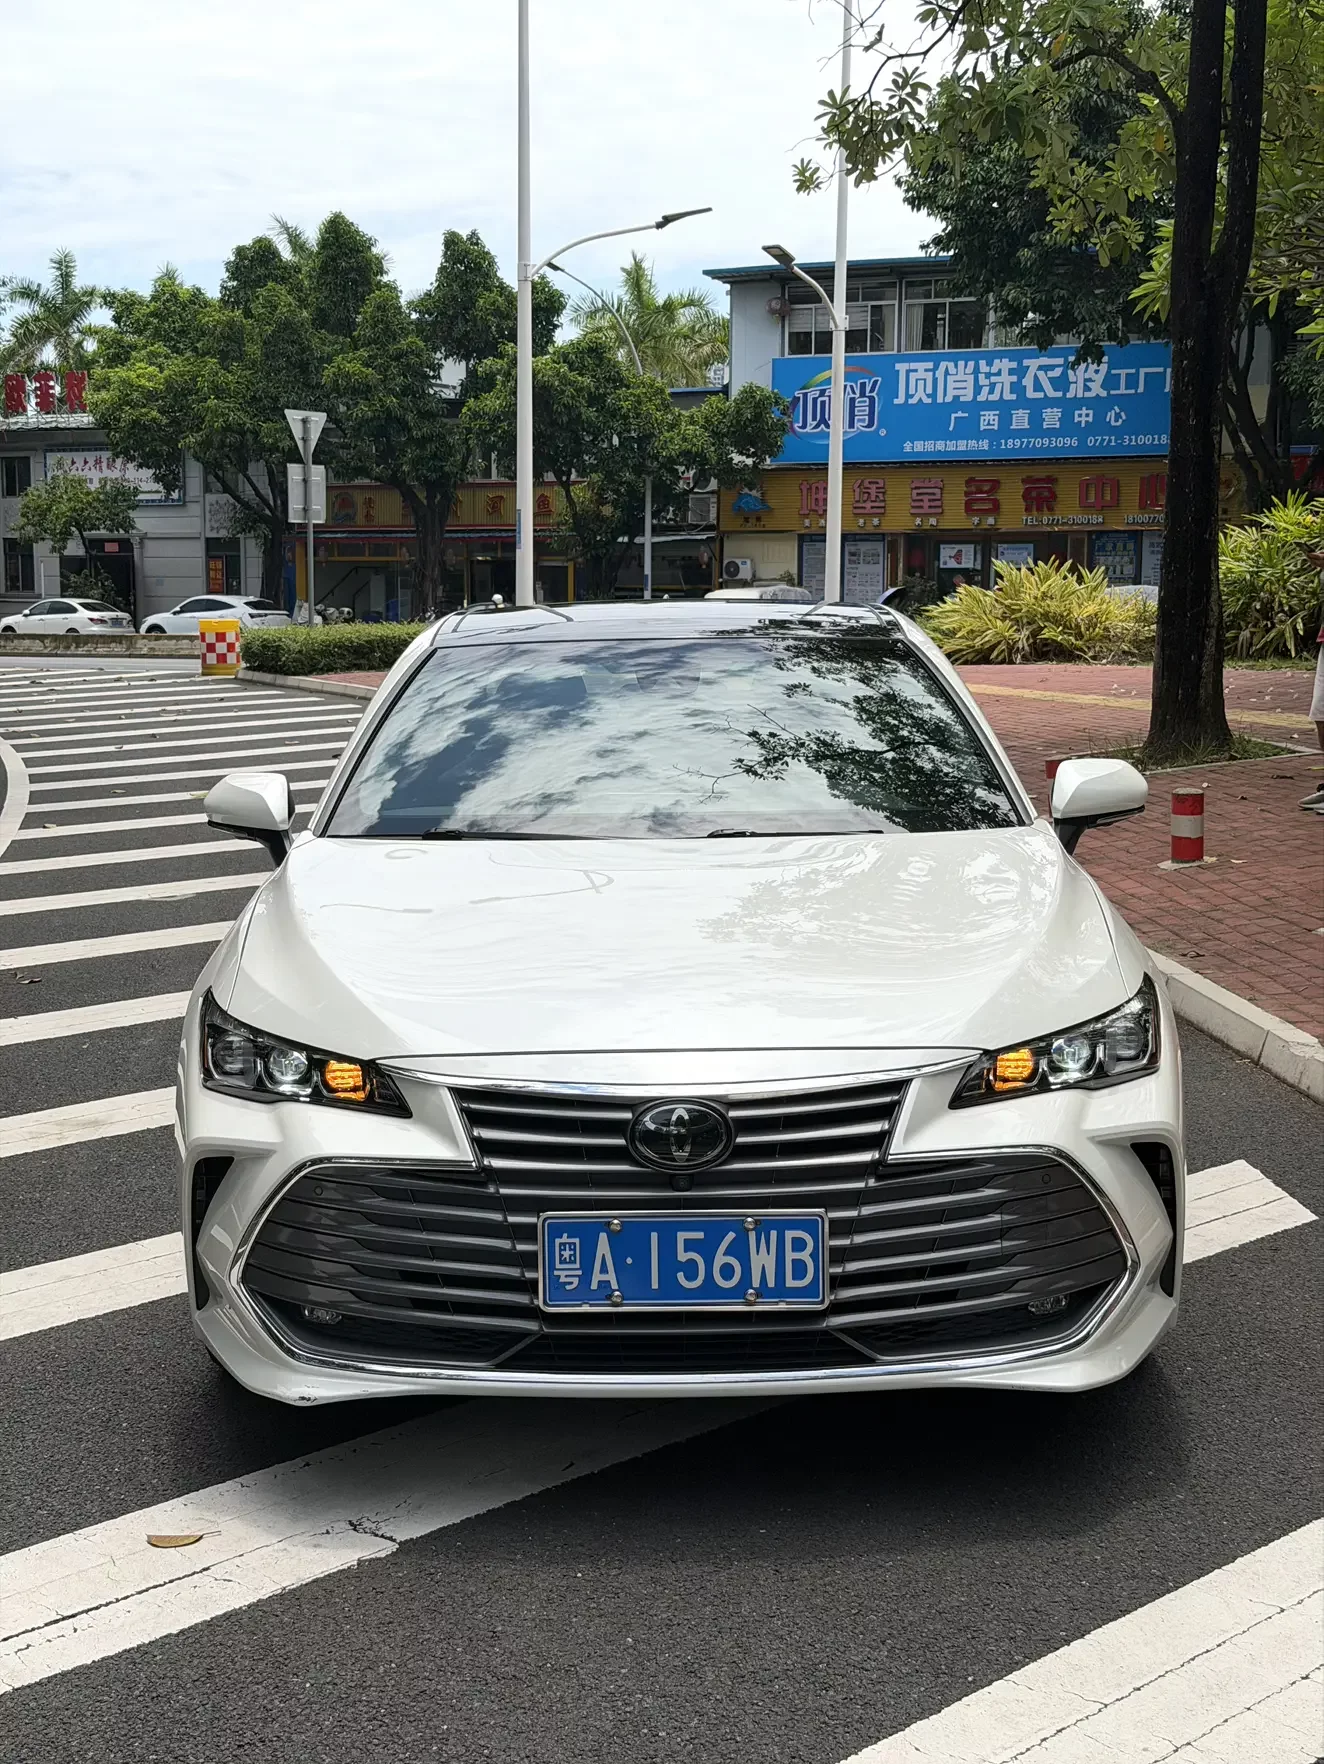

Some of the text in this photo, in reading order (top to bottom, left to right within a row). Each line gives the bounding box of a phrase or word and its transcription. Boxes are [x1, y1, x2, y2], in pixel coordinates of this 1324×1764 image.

[893, 352, 1171, 404] 顶俏洗衣液工厂
[949, 405, 1127, 431] 广西直营中心
[1087, 433, 1171, 446] 0771-310018
